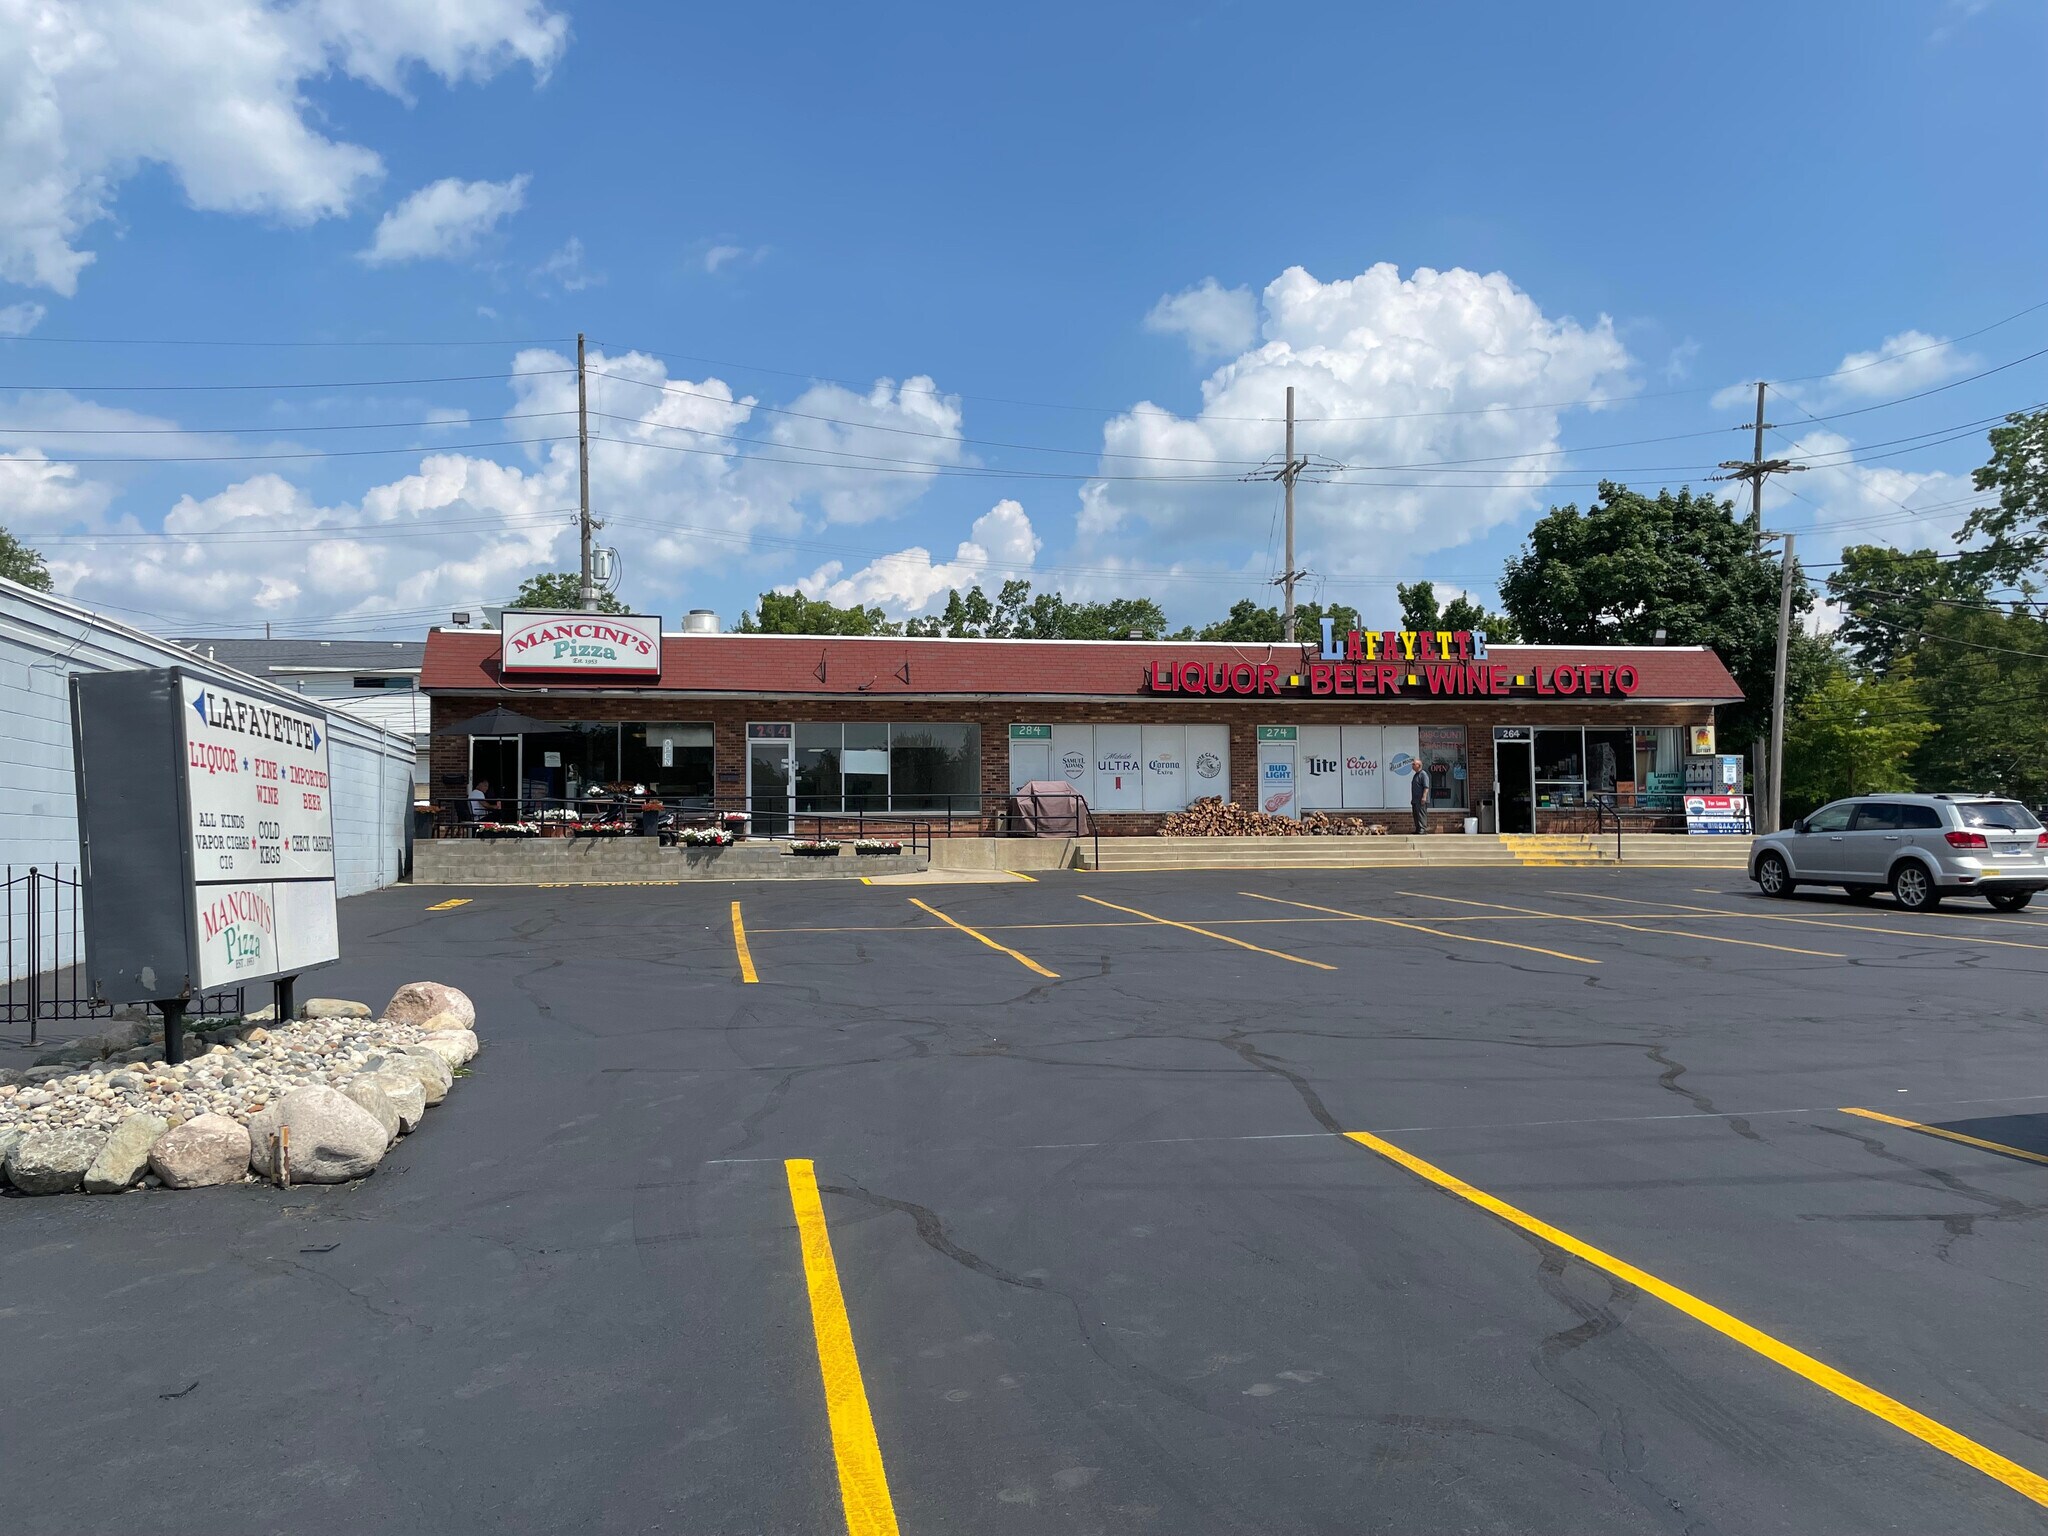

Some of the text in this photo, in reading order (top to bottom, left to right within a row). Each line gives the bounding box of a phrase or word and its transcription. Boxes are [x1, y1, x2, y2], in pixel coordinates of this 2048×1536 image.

[511, 624, 652, 655] MANCINI'S
[1319, 617, 1488, 660] LAFAYETTE
[553, 638, 617, 660] Pizza
[1150, 660, 1639, 695] LIQUOR BEER WINE LOTTO
[207, 693, 313, 751] LAFAYETTE
[756, 725, 788, 737] 294
[1019, 725, 1041, 736] 284
[1266, 728, 1287, 737] 274
[1503, 729, 1520, 738] 264
[664, 739, 672, 766] OPEN
[189, 741, 329, 789] LIQUOR FINE IMPORTED
[1097, 761, 1140, 771] ULTRA
[1148, 760, 1180, 771] Corona
[1309, 758, 1337, 776] Lite
[1346, 756, 1378, 769] Coors
[1430, 764, 1447, 772] OPEN
[1265, 771, 1291, 779] LIGHT
[256, 785, 279, 805] WINE
[302, 793, 322, 811] BEER
[199, 812, 245, 829] ALL KINDS
[259, 821, 280, 840] COLD
[195, 834, 250, 850] VAPOR CIGARS
[292, 835, 332, 852] CHECK CASHING
[219, 855, 234, 870] CIG
[259, 846, 281, 864] KEGS
[202, 890, 271, 943] MANCINI'S
[223, 924, 261, 965] Pizza
